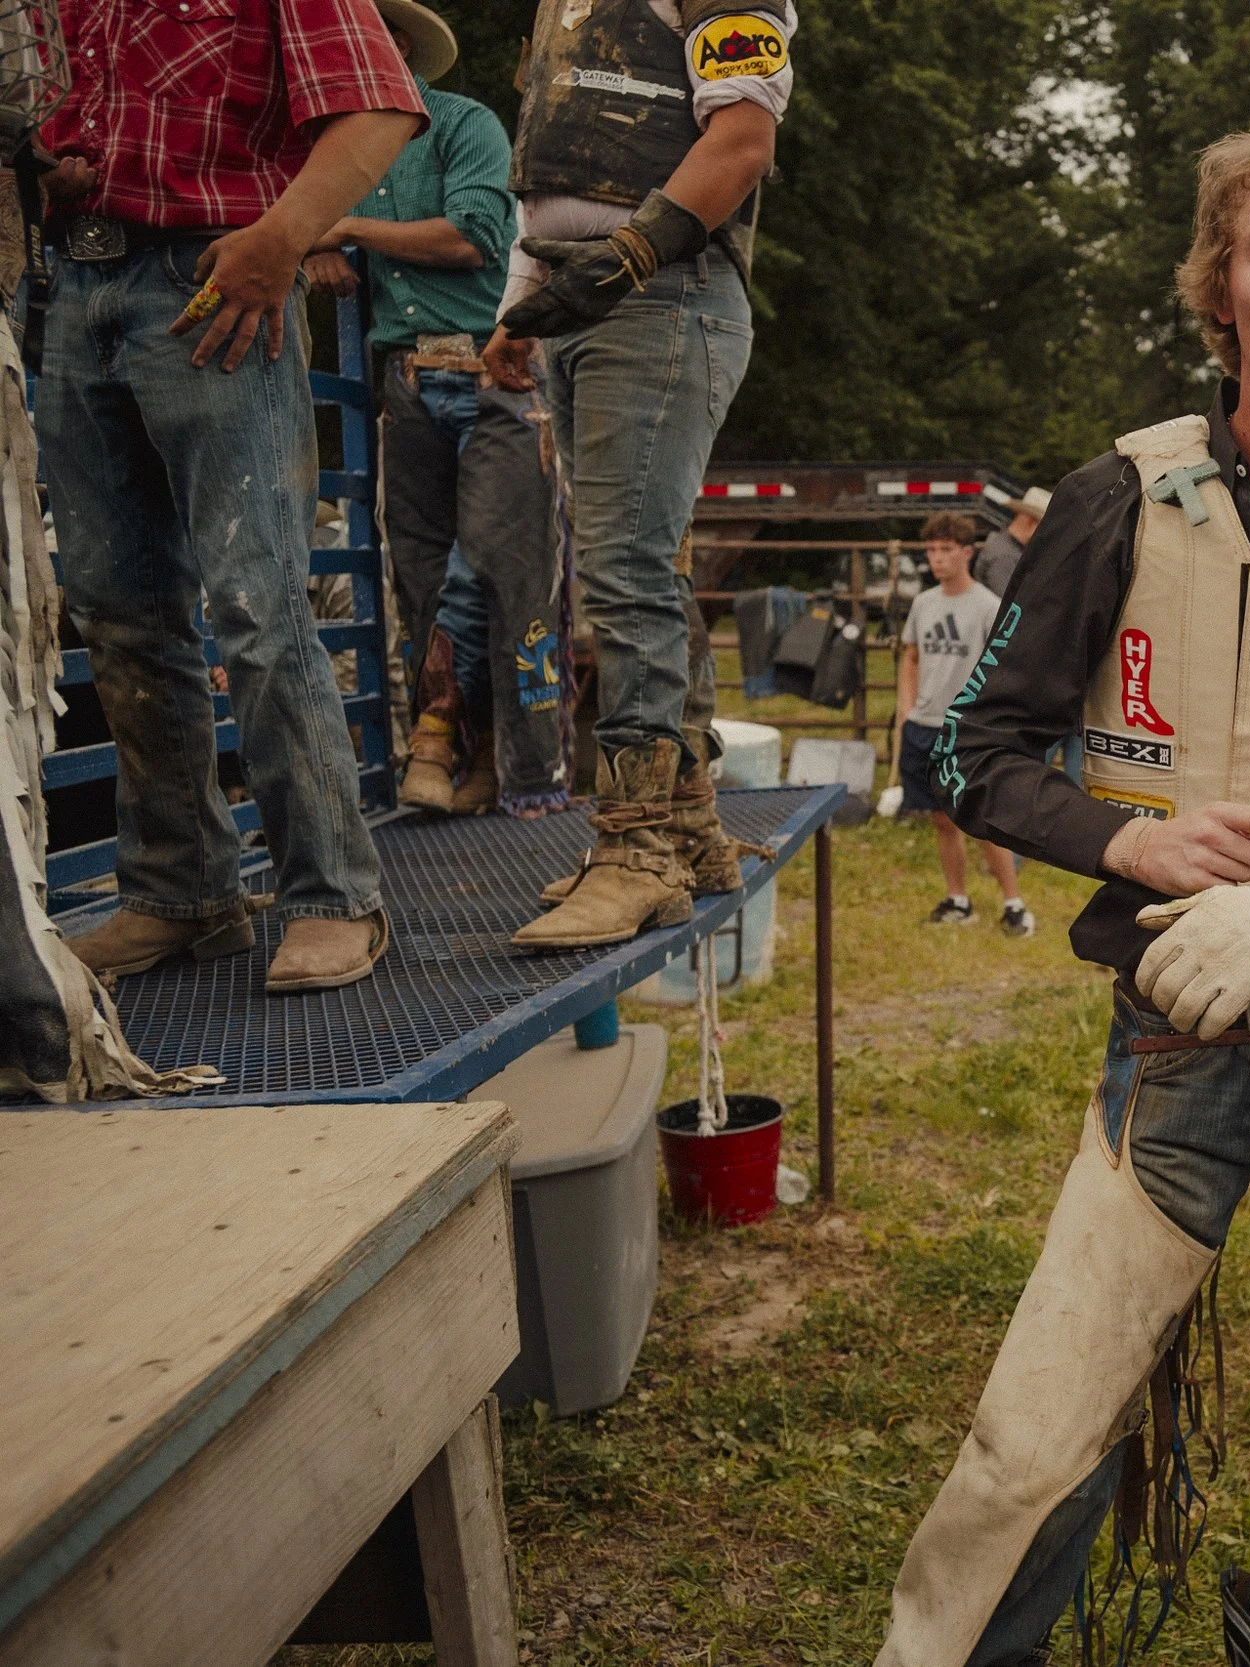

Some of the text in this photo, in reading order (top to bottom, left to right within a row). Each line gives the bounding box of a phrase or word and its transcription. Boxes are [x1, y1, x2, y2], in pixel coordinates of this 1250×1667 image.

[583, 71, 625, 84] GATEWAY
[1125, 636, 1156, 724] HYER
[1089, 734, 1156, 762] BEX
